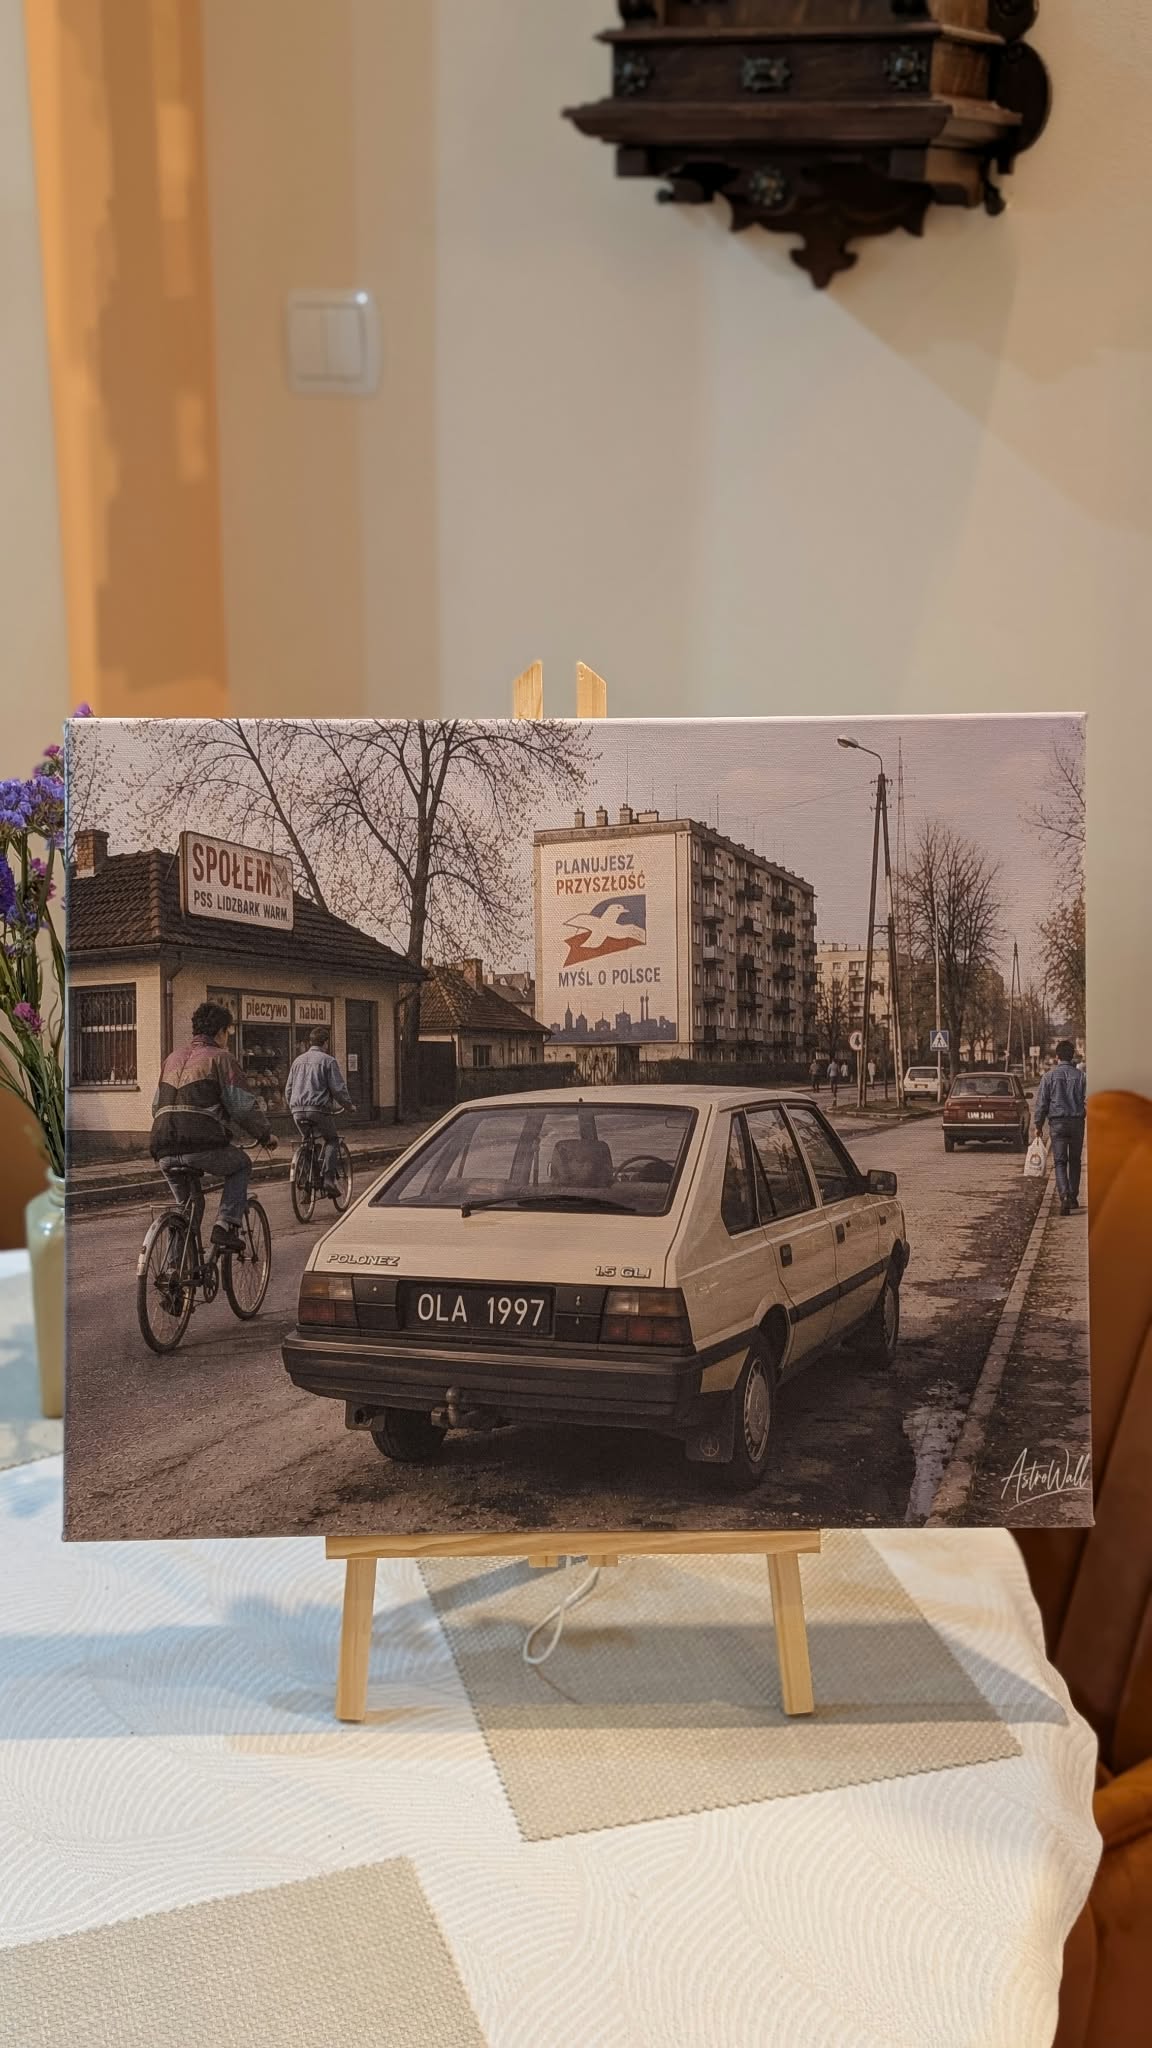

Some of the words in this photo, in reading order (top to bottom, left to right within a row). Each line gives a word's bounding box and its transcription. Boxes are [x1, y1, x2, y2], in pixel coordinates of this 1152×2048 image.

[192, 842, 272, 896] SPOŁEM
[555, 854, 635, 875] PLANUJESZ
[556, 870, 646, 895] PRZYSZŁOŚĆ
[193, 889, 213, 909] PSS
[217, 894, 260, 917] LIDZBARK
[263, 904, 290, 922] WARM.
[558, 967, 593, 988] MYŚL
[598, 970, 607, 985] O
[612, 967, 661, 985] POLSCE
[246, 998, 288, 1020] pieczywo
[326, 1253, 401, 1267] POLONEZ
[620, 1266, 652, 1279] GLI
[417, 1293, 468, 1323] OLA
[487, 1296, 545, 1327] 1997
[1000, 1447, 1091, 1505] AstroWall
